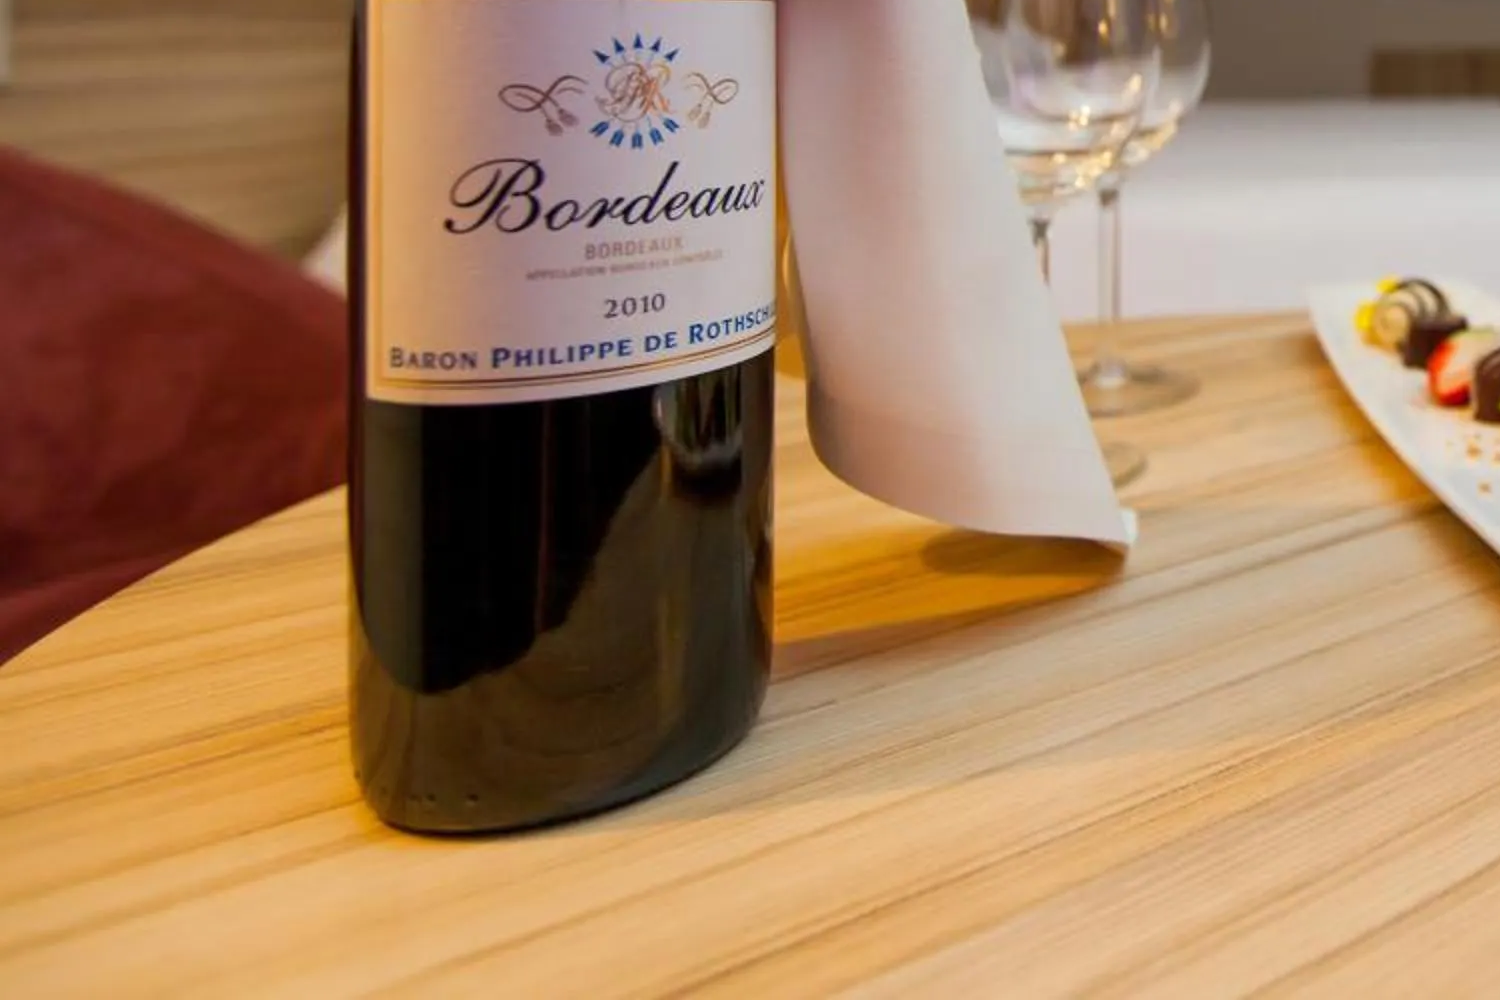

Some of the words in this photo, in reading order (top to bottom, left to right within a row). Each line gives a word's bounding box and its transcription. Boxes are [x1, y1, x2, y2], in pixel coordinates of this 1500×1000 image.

[443, 157, 766, 235] Bordeaux
[585, 237, 684, 260] BORDEAUX
[604, 293, 665, 319] 2010
[390, 346, 478, 369] BARON
[492, 339, 632, 368] PHILIPPE
[645, 331, 678, 352] DE
